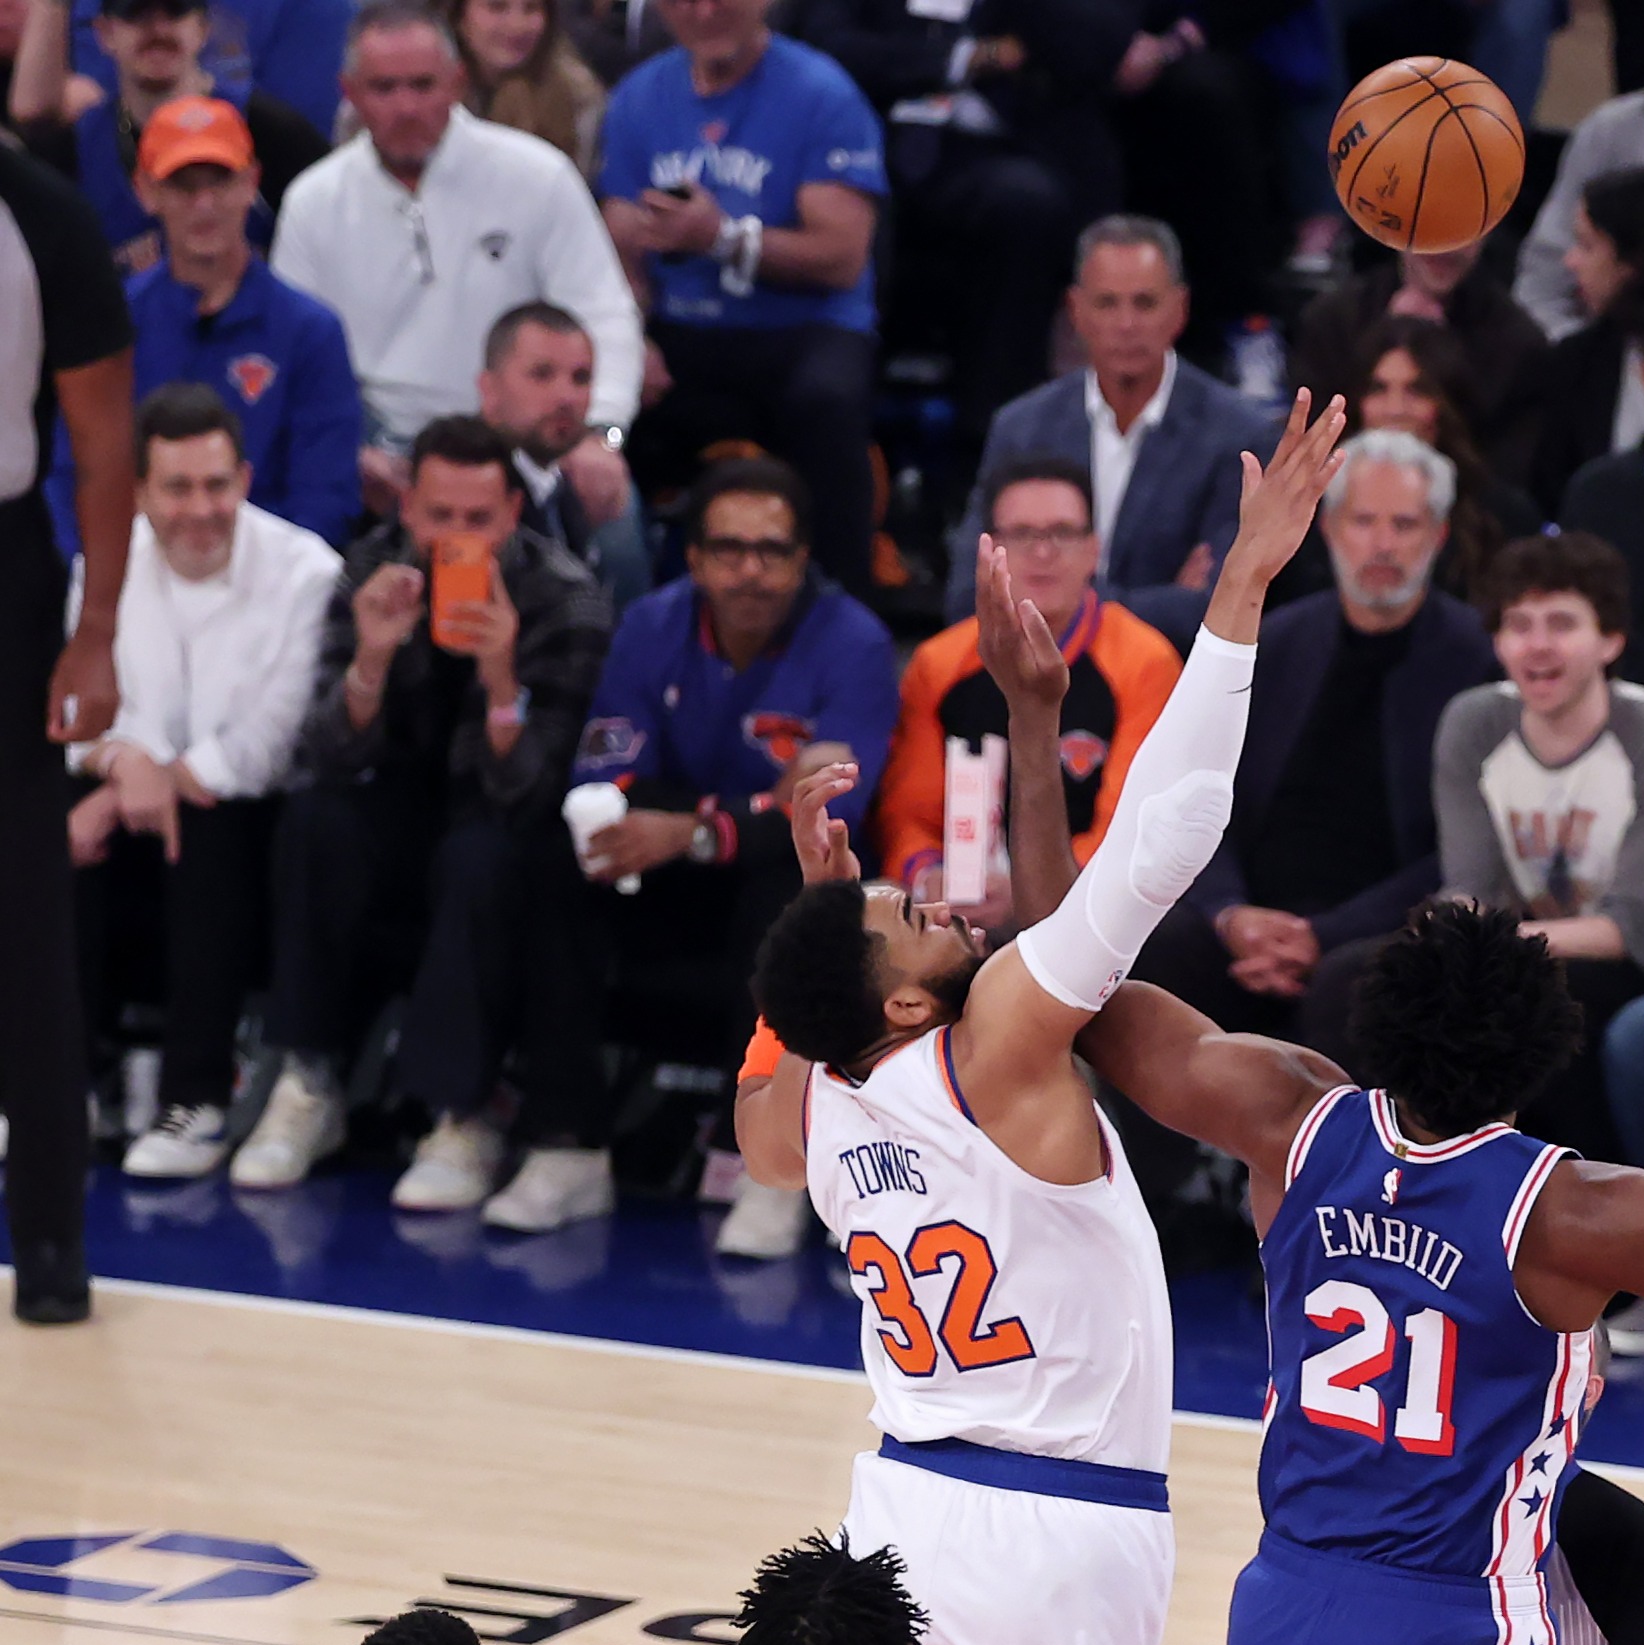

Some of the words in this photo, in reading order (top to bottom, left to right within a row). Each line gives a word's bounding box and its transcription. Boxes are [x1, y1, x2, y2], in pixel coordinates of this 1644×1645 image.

[839, 1142, 927, 1199] TOWNS
[846, 1219, 1037, 1377] 32
[1315, 1205, 1463, 1291] EMBIID
[1300, 1279, 1459, 1457] 21
